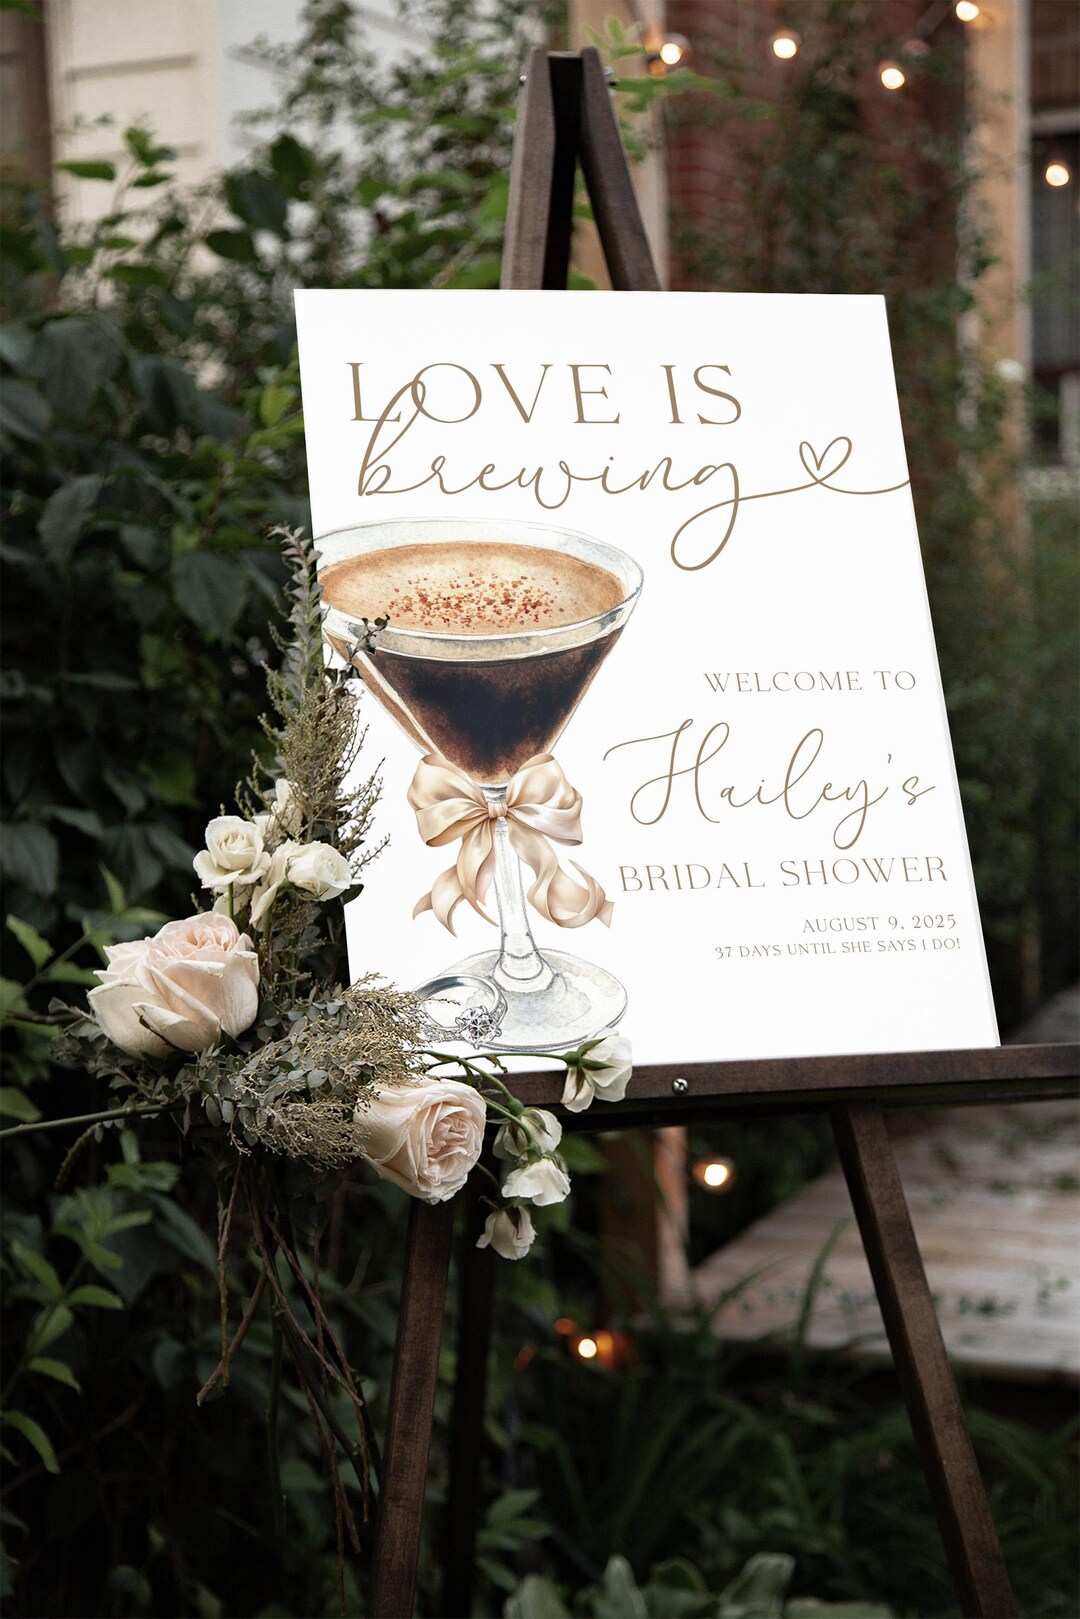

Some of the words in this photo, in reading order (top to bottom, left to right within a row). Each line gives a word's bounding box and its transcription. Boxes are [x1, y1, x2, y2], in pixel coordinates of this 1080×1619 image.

[346, 361, 621, 426] LOVE
[659, 363, 743, 426] IS
[356, 379, 744, 572] brewing
[702, 670, 863, 694] WELCOME
[873, 669, 917, 692] TO
[602, 718, 936, 850] Hailey's
[618, 861, 766, 893] BRIDAL
[779, 855, 949, 888] SHOWER
[802, 916, 880, 934] AUGUST
[911, 913, 957, 931] 2025
[715, 945, 733, 960] 37
[739, 943, 782, 959] DAYS
[787, 942, 837, 956] UNTIL
[841, 940, 873, 954] SHE
[877, 939, 918, 953] SAYS
[921, 938, 928, 951] I
[932, 937, 962, 951] DO!
